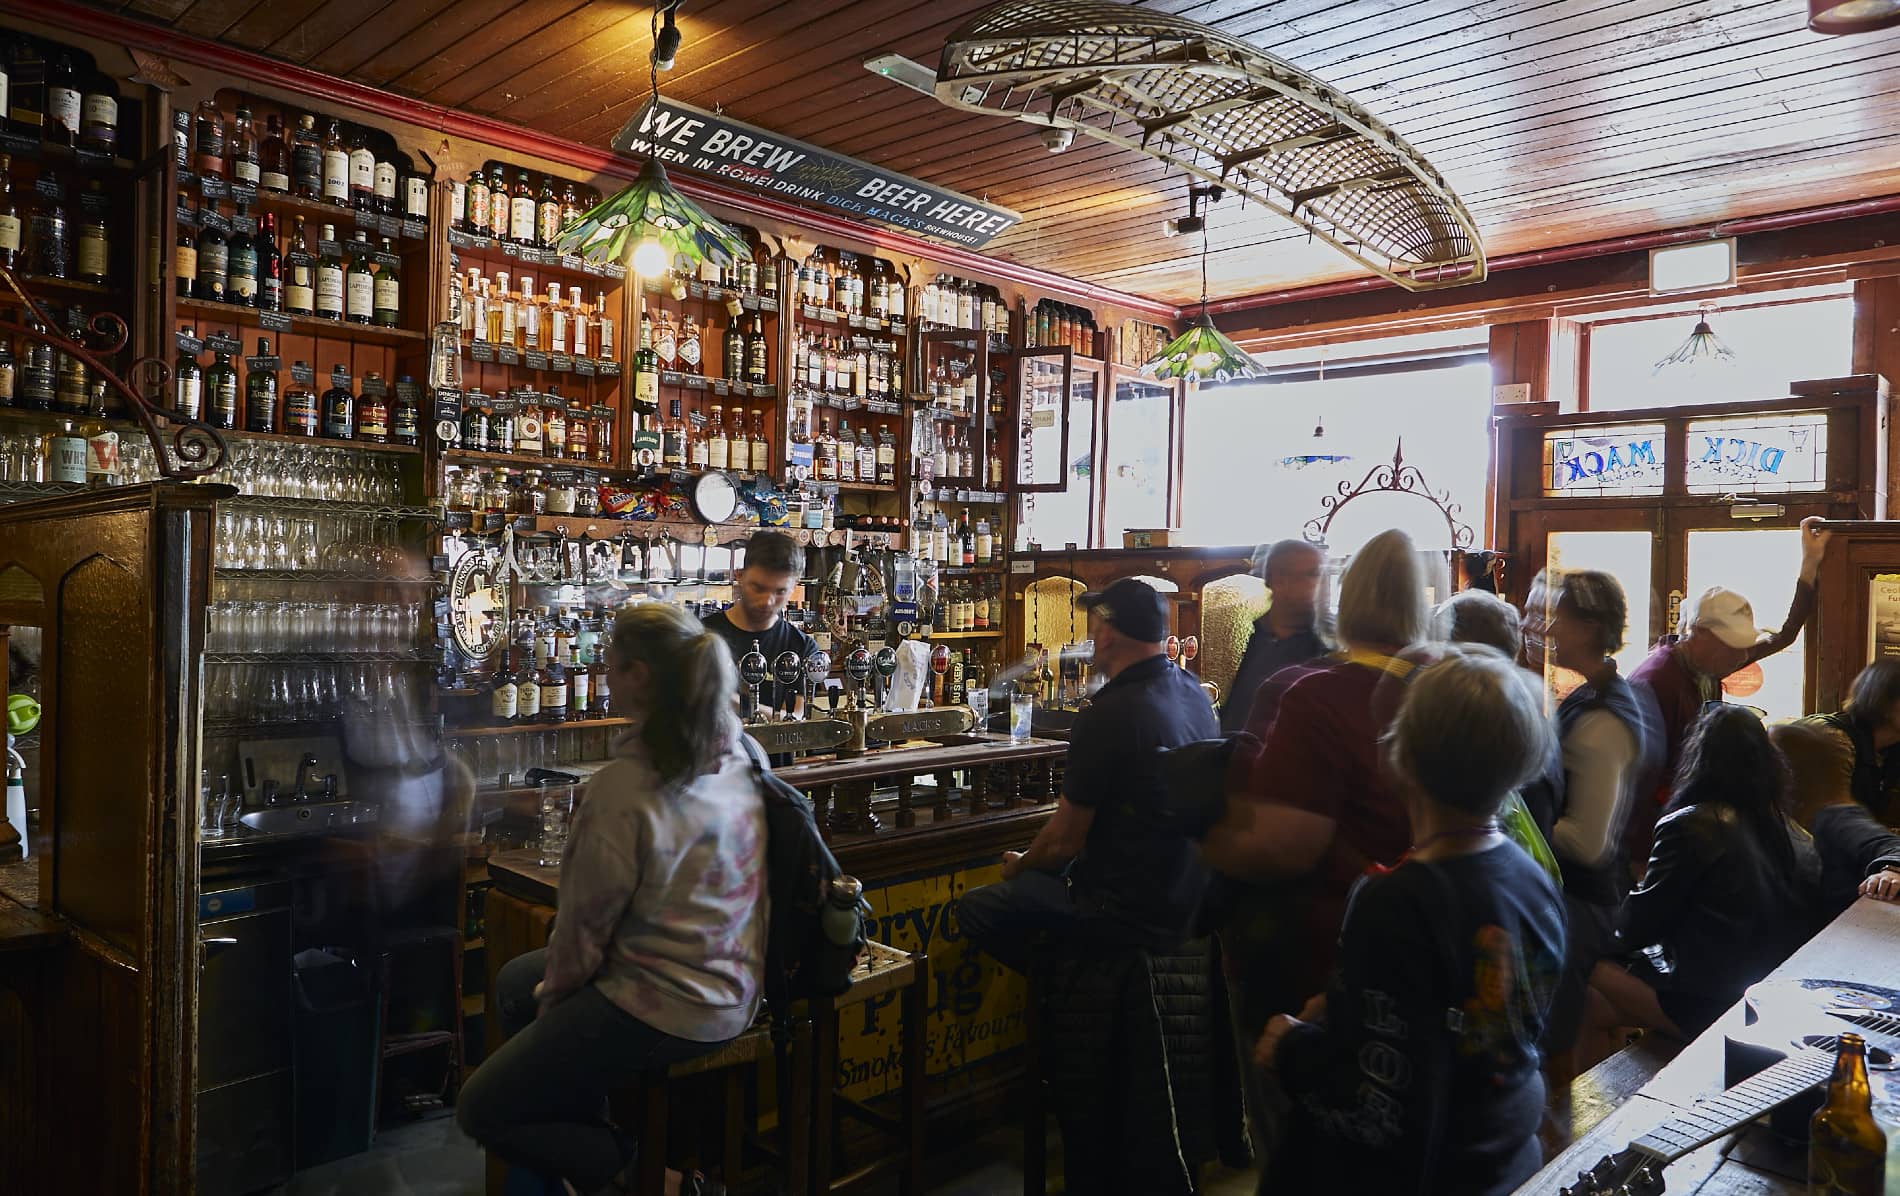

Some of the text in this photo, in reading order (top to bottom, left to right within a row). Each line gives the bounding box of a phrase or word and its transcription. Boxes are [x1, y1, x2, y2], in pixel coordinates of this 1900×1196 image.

[630, 138, 690, 164] WHEN
[692, 157, 715, 170] IN
[773, 179, 824, 201] DRINK
[824, 195, 865, 212] DICK
[866, 206, 925, 229] MACK'S
[924, 223, 979, 245] BREWHOUSE!
[639, 106, 705, 146] WE
[700, 128, 806, 173] BREW
[855, 177, 932, 213] BEER
[925, 200, 1015, 236] HERE!
